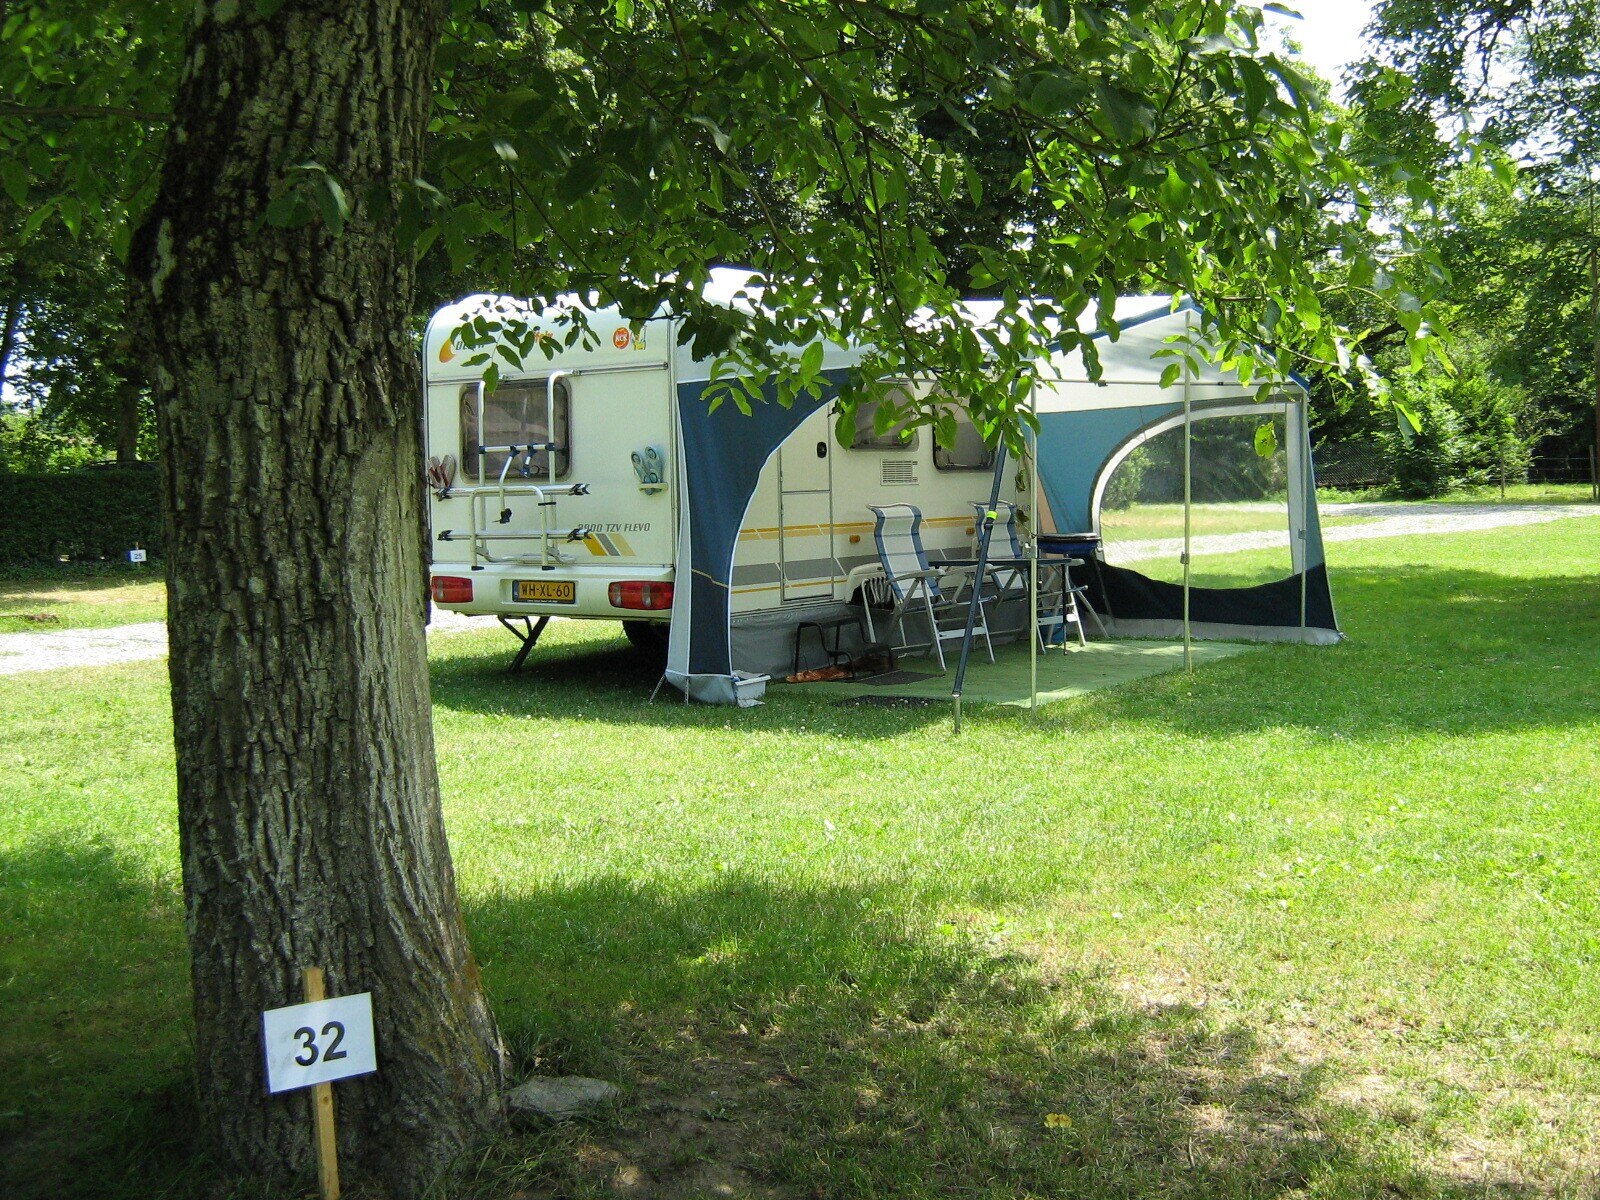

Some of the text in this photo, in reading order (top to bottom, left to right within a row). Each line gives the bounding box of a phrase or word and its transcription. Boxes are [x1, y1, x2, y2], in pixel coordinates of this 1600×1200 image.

[606, 523, 622, 533] TZV
[624, 522, 651, 532] FLEVO
[521, 583, 571, 598] WH-XL-60
[293, 1020, 348, 1067] 32
